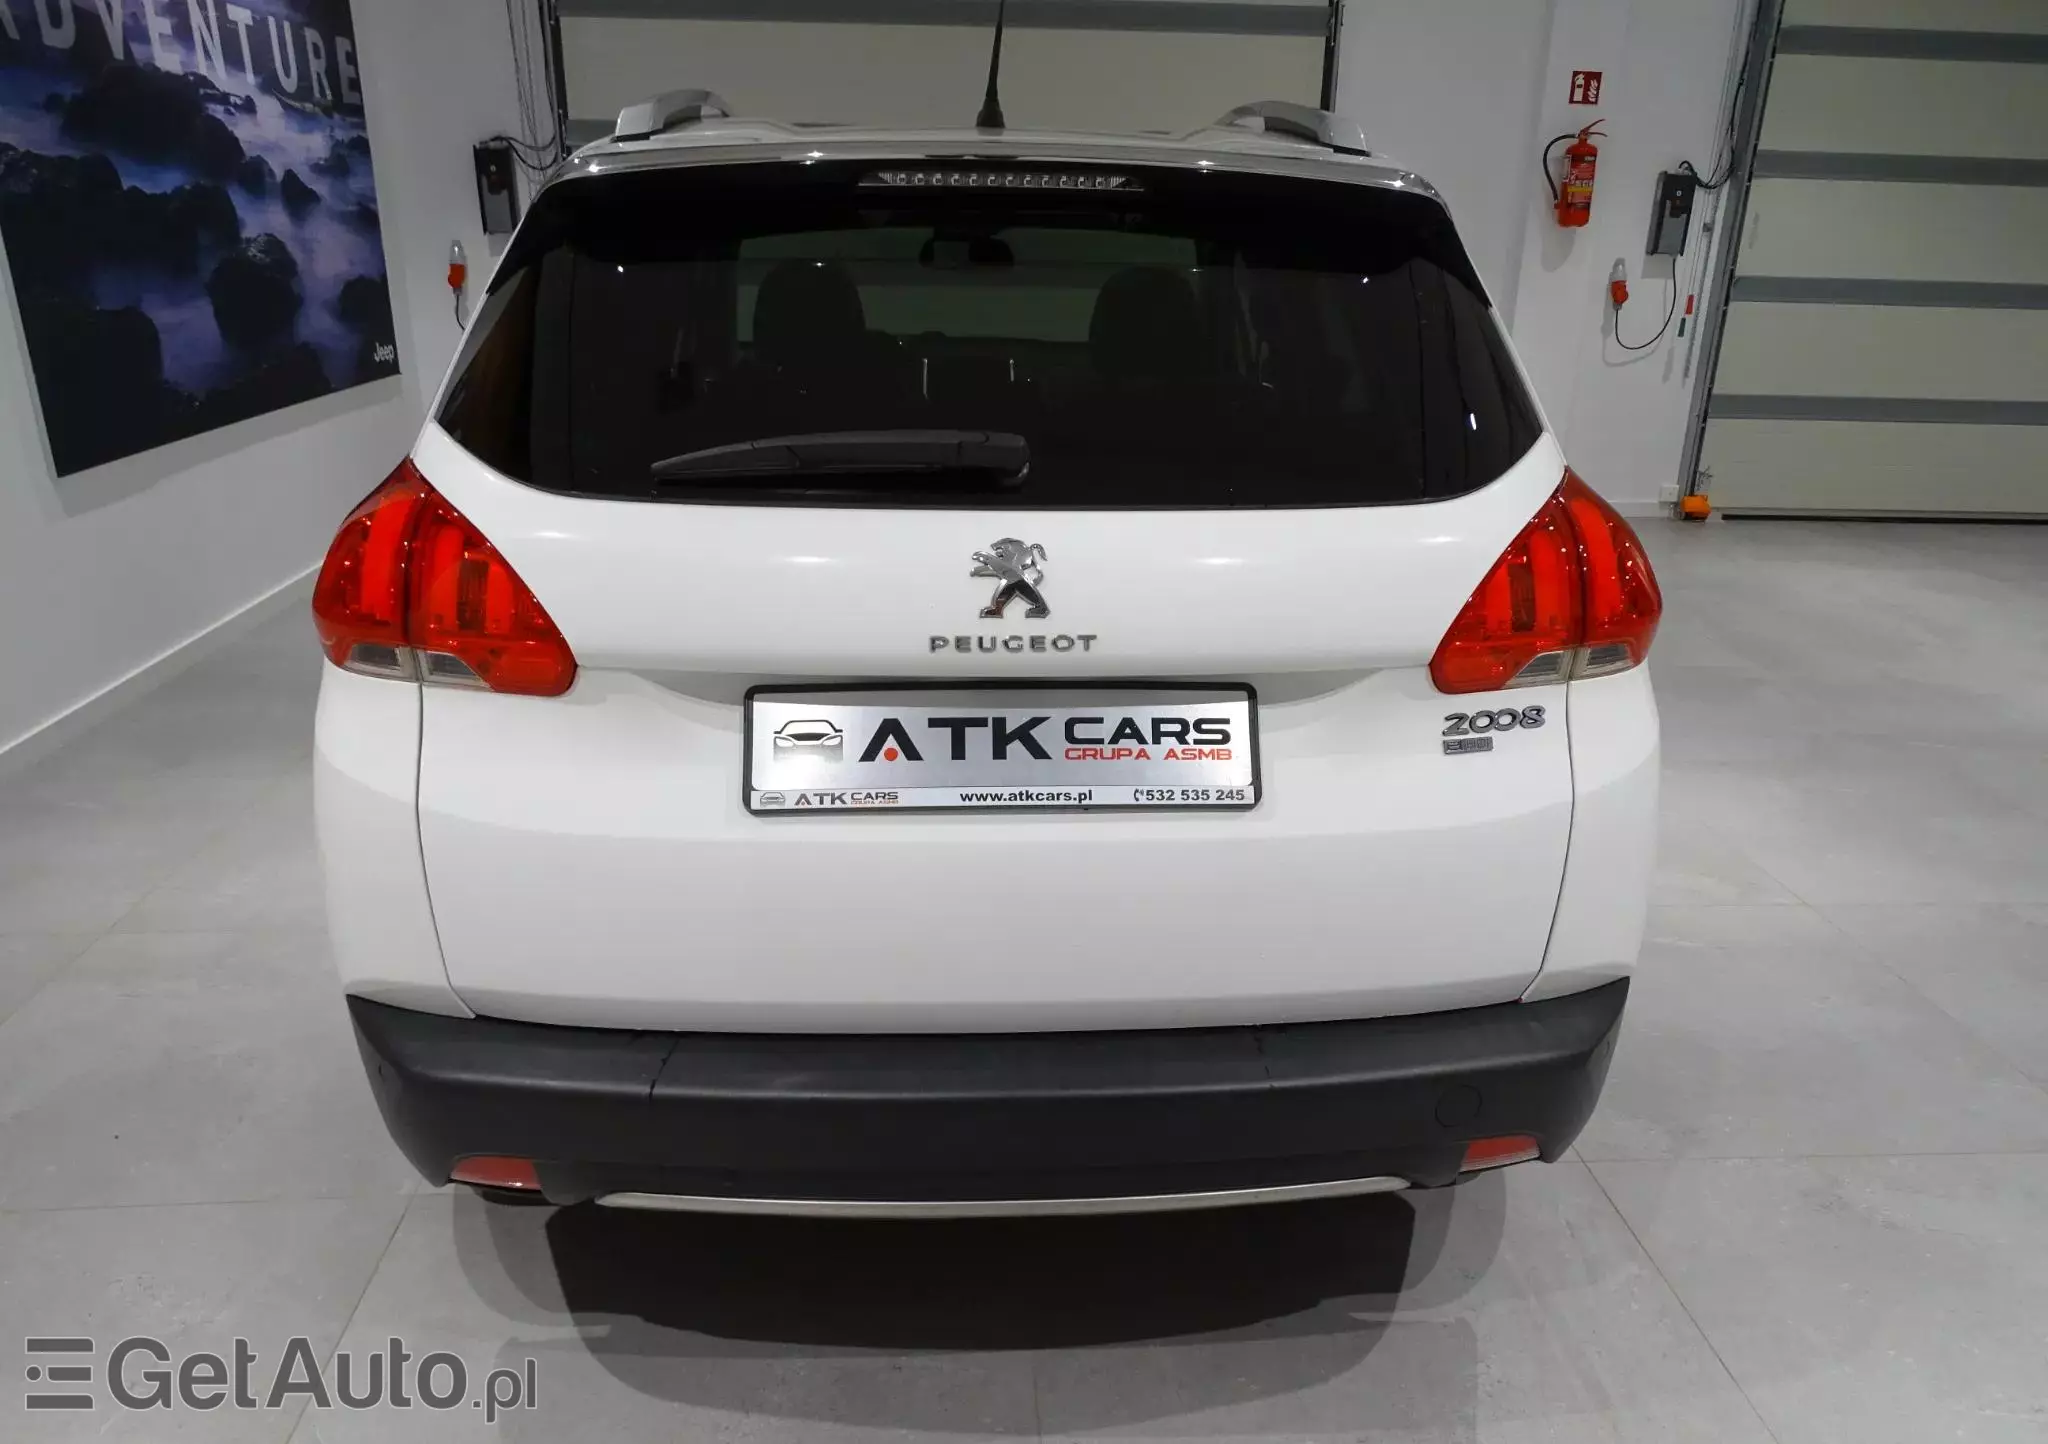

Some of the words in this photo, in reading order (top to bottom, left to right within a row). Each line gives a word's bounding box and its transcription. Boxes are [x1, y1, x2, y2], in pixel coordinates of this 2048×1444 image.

[0, 0, 363, 106] DVENTURE
[373, 341, 395, 363] Jeep
[929, 634, 1098, 653] PEUGEOT
[1442, 705, 1546, 736] 2008
[858, 716, 1053, 762] ATK
[1064, 717, 1232, 745] CARS
[1064, 747, 1151, 761] GRUPA
[1163, 747, 1233, 761] ASMB
[794, 792, 848, 806] ATK
[850, 791, 899, 801] CARS
[959, 789, 1093, 803] www.atkcars.pl
[1146, 789, 1176, 801] 532
[1180, 789, 1211, 801] 535
[1215, 789, 1245, 801] 245
